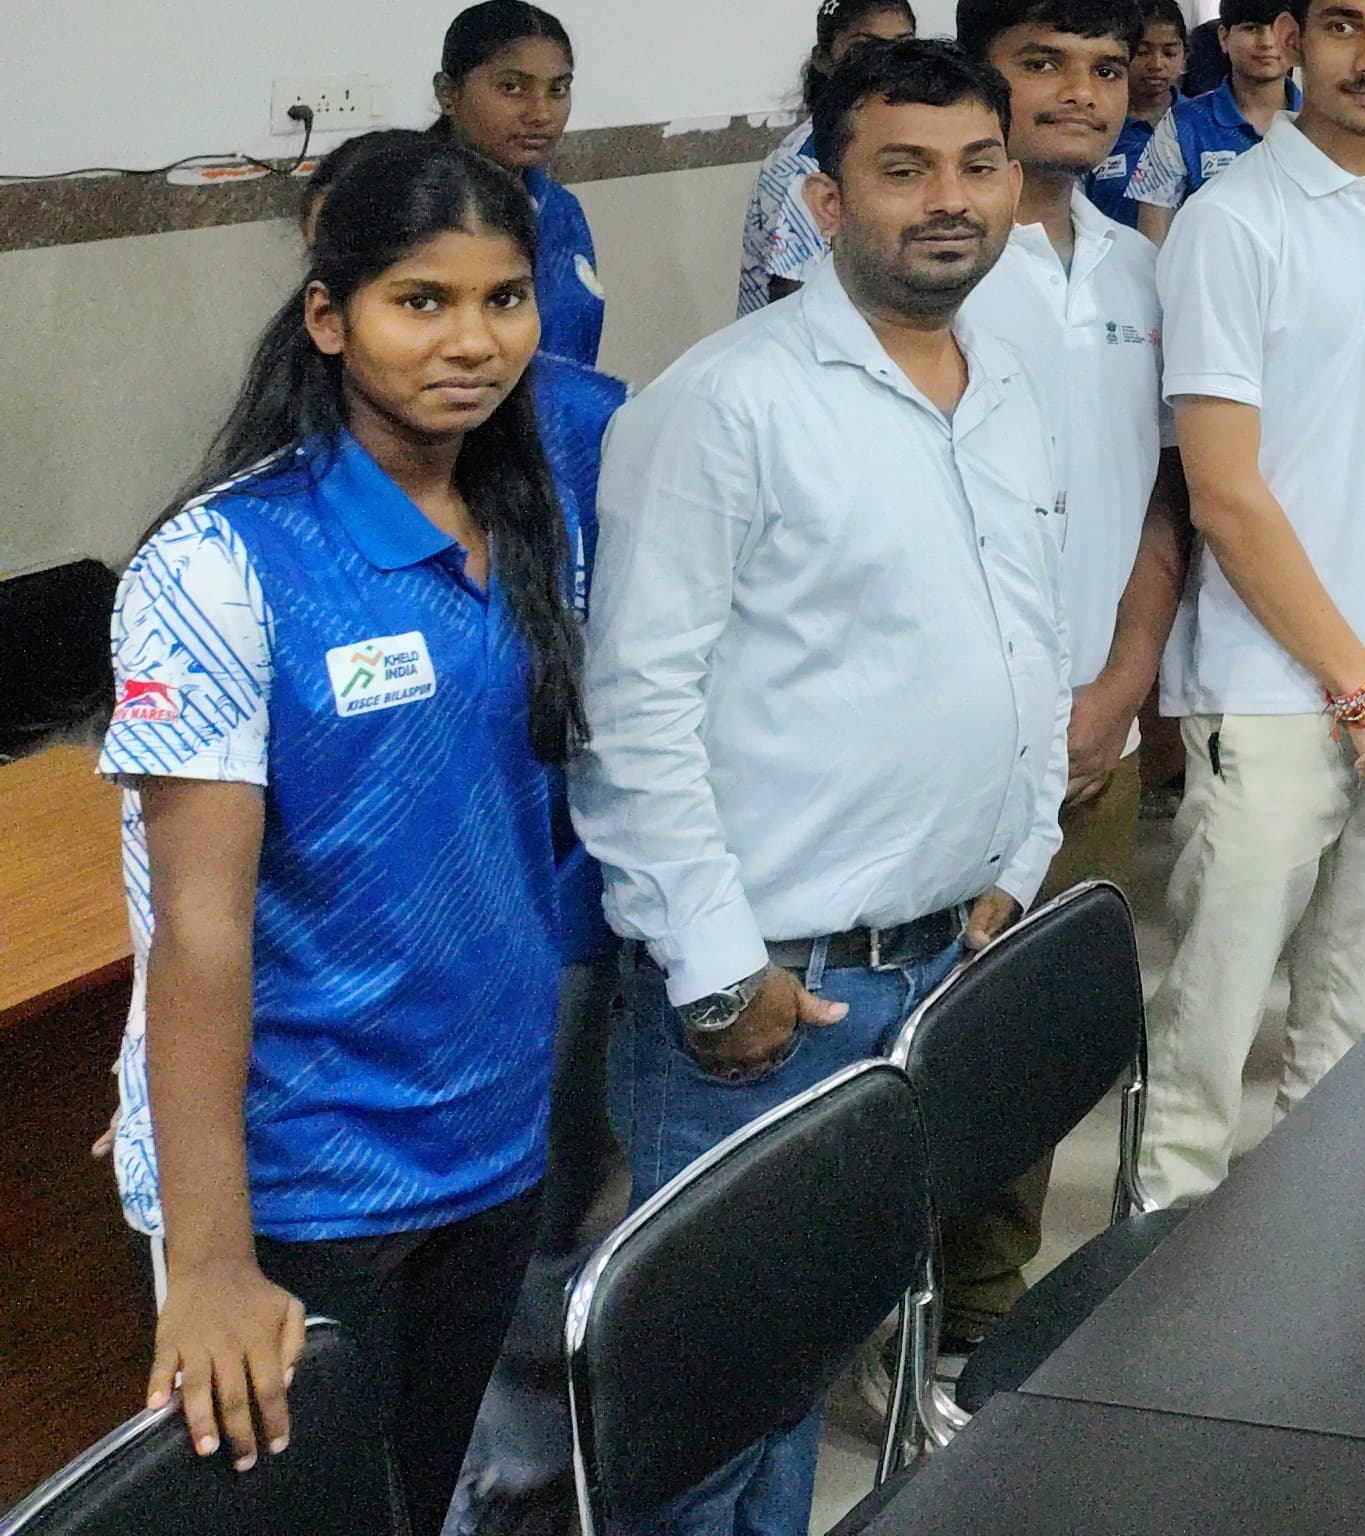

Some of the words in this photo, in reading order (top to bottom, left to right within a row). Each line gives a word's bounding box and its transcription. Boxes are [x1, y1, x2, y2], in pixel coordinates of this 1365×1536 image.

[383, 651, 420, 668] KHELO
[384, 664, 419, 681] INDIA
[383, 683, 432, 704] BILASPUR
